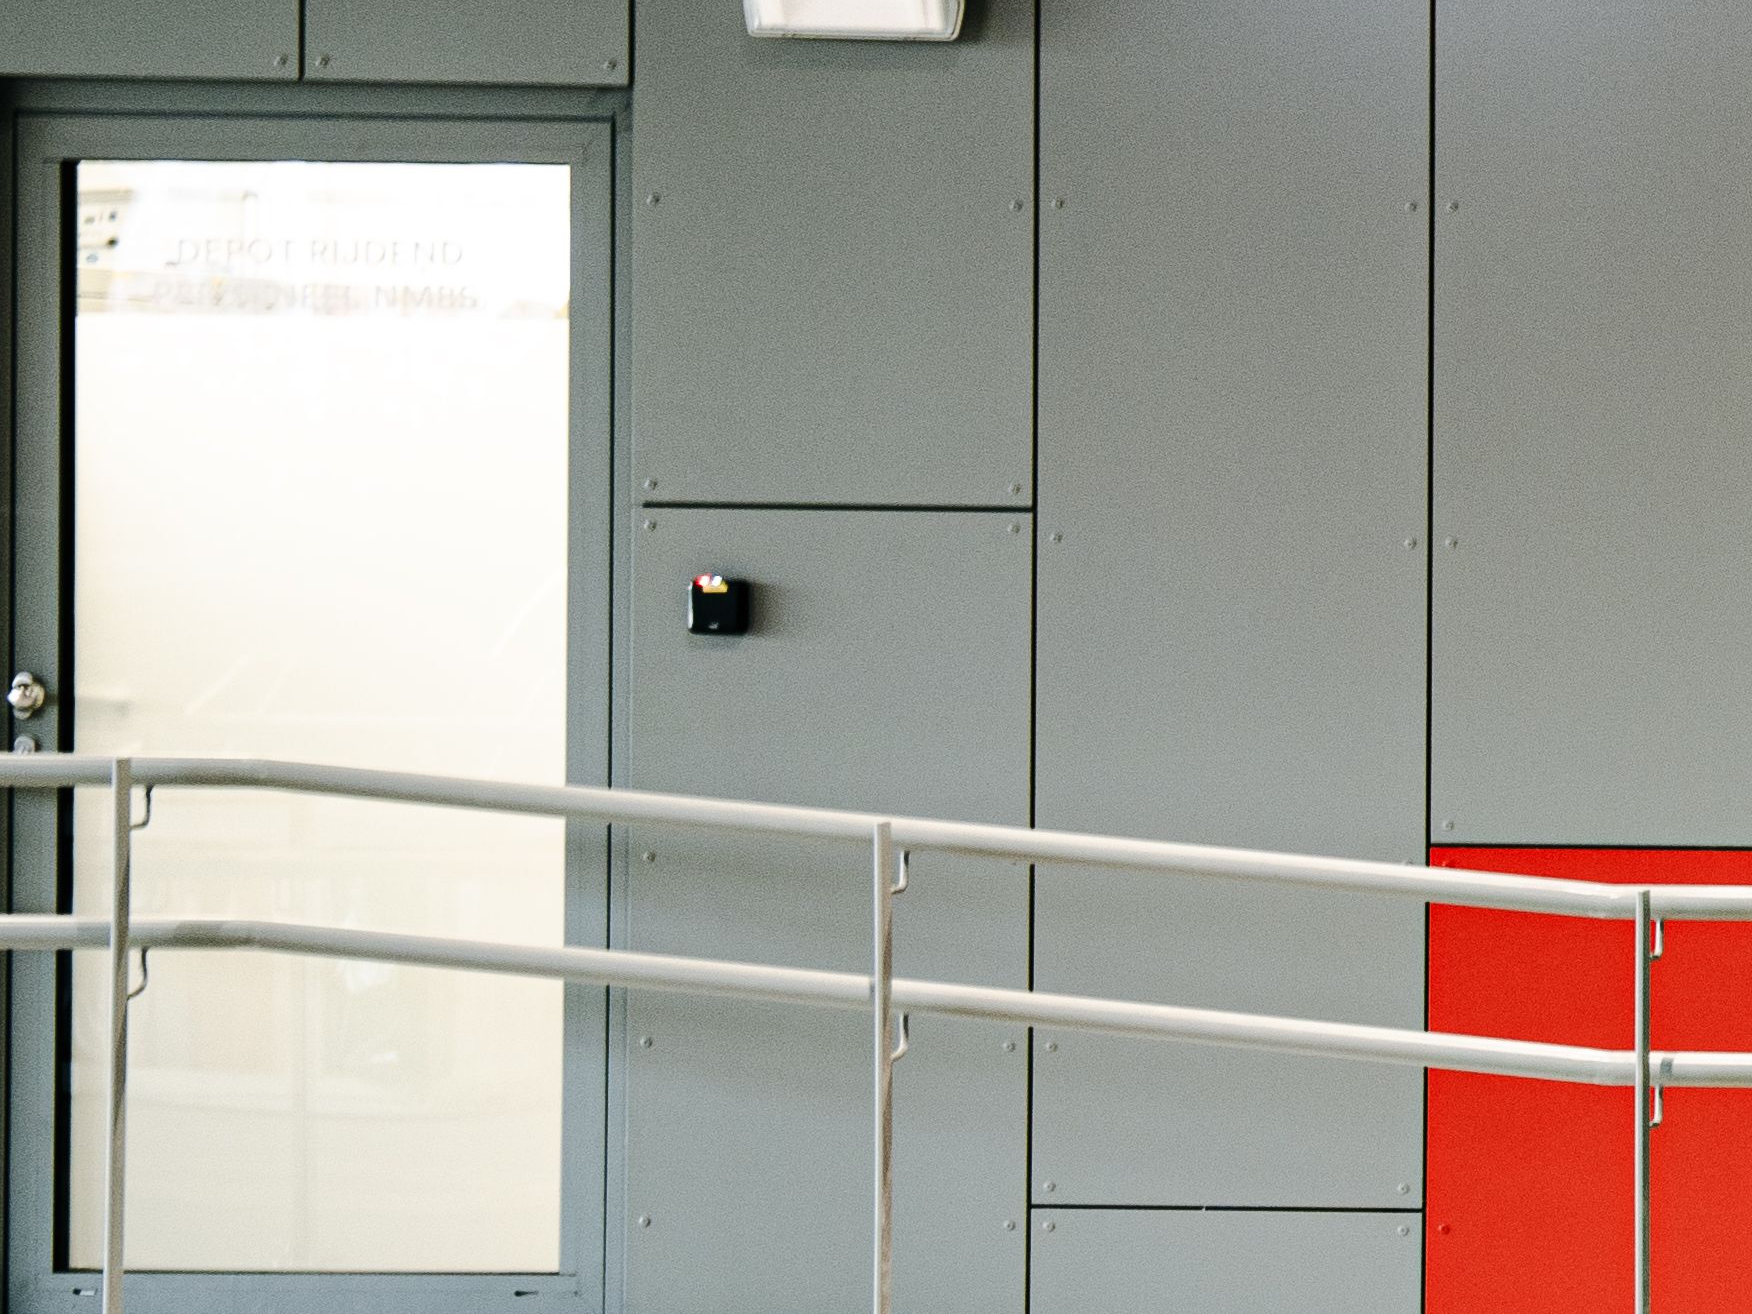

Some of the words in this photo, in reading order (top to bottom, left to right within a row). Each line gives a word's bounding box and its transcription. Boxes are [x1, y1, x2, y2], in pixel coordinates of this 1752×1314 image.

[177, 238, 295, 265] DEPOT
[311, 238, 464, 265] RIJDEND
[153, 283, 361, 309] PERNEEL
[374, 284, 479, 309] NMBS
